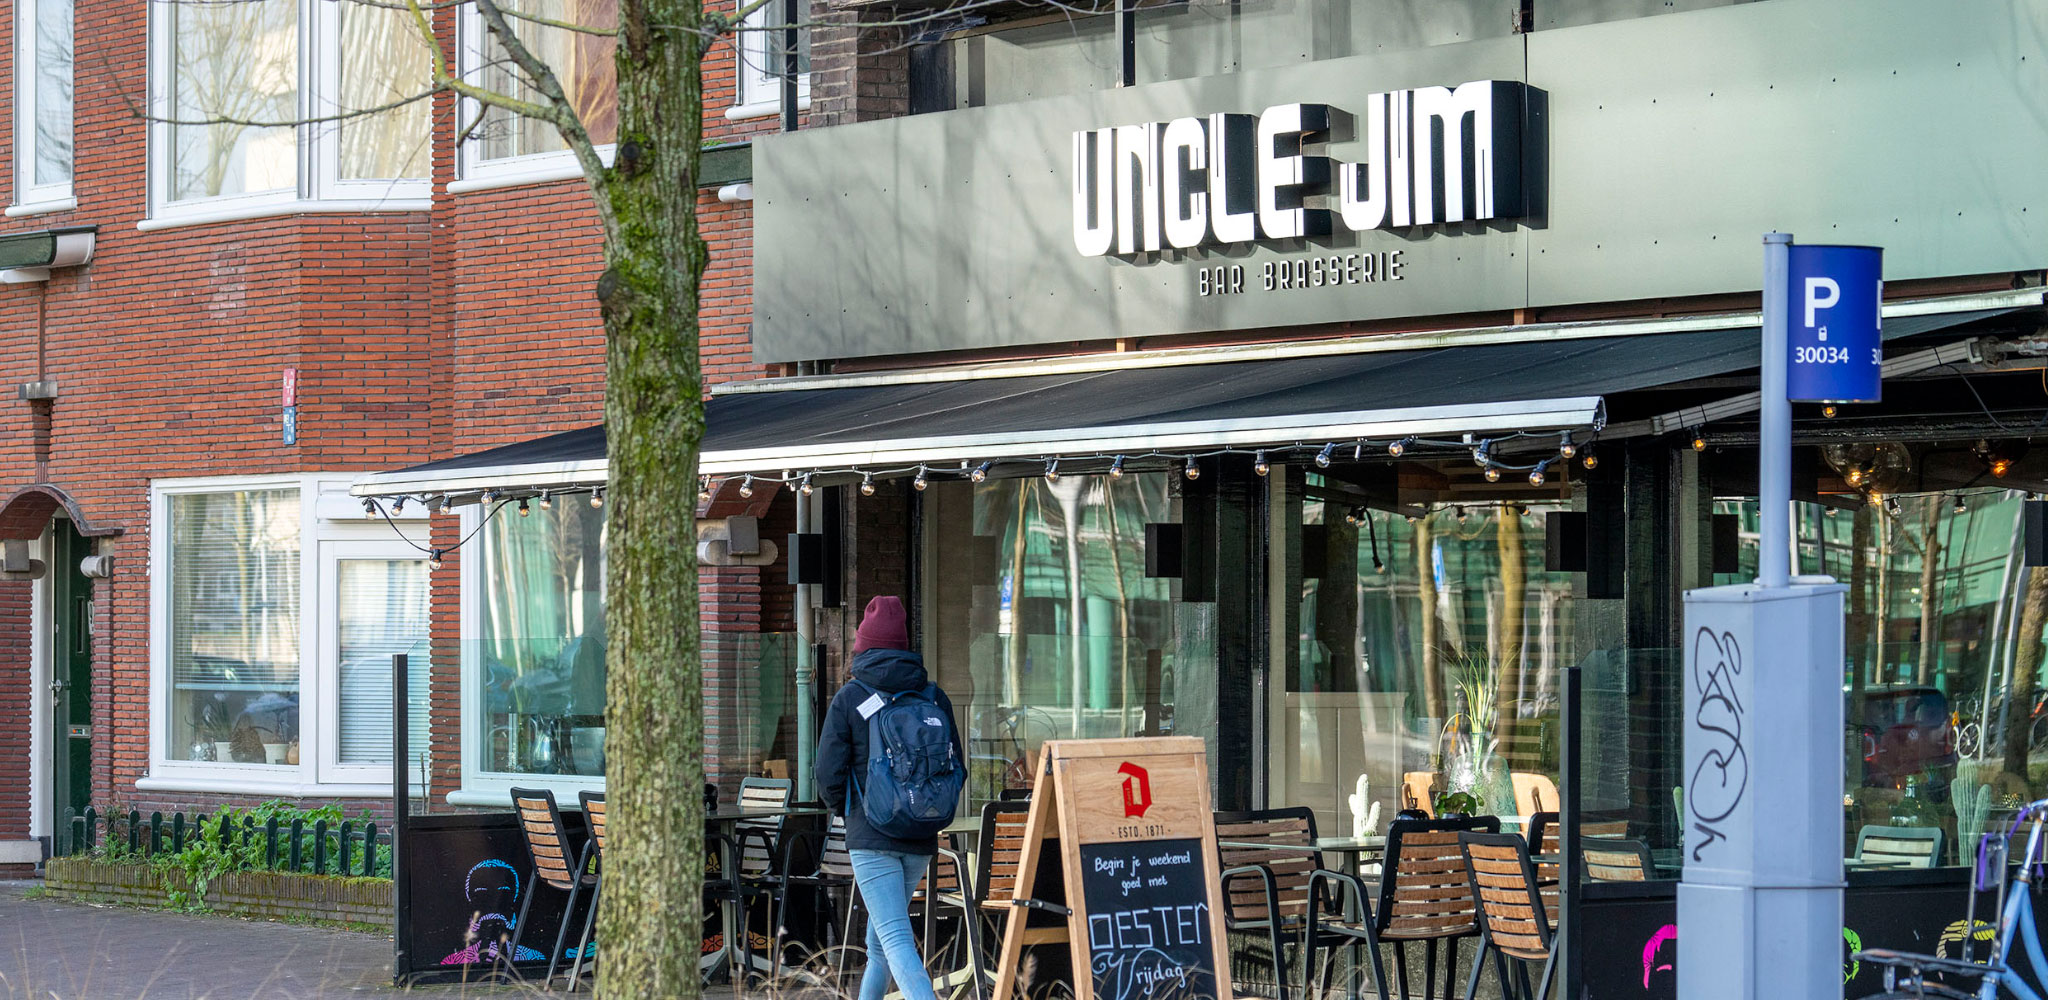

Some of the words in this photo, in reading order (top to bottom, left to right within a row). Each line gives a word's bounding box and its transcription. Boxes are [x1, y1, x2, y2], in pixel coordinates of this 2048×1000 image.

[1073, 103, 1302, 257] UNCLE
[1340, 80, 1494, 231] JIM
[1199, 264, 1244, 297] BAR
[1263, 250, 1405, 292] BRASSERIE
[1804, 277, 1841, 328] P
[1794, 346, 1849, 364] 30034
[1145, 825, 1165, 837] 1871
[1094, 857, 1124, 877] Begin
[1130, 855, 1141, 877] je
[1148, 850, 1191, 867] weekend
[1121, 876, 1141, 896] goed
[1148, 875, 1168, 887] met
